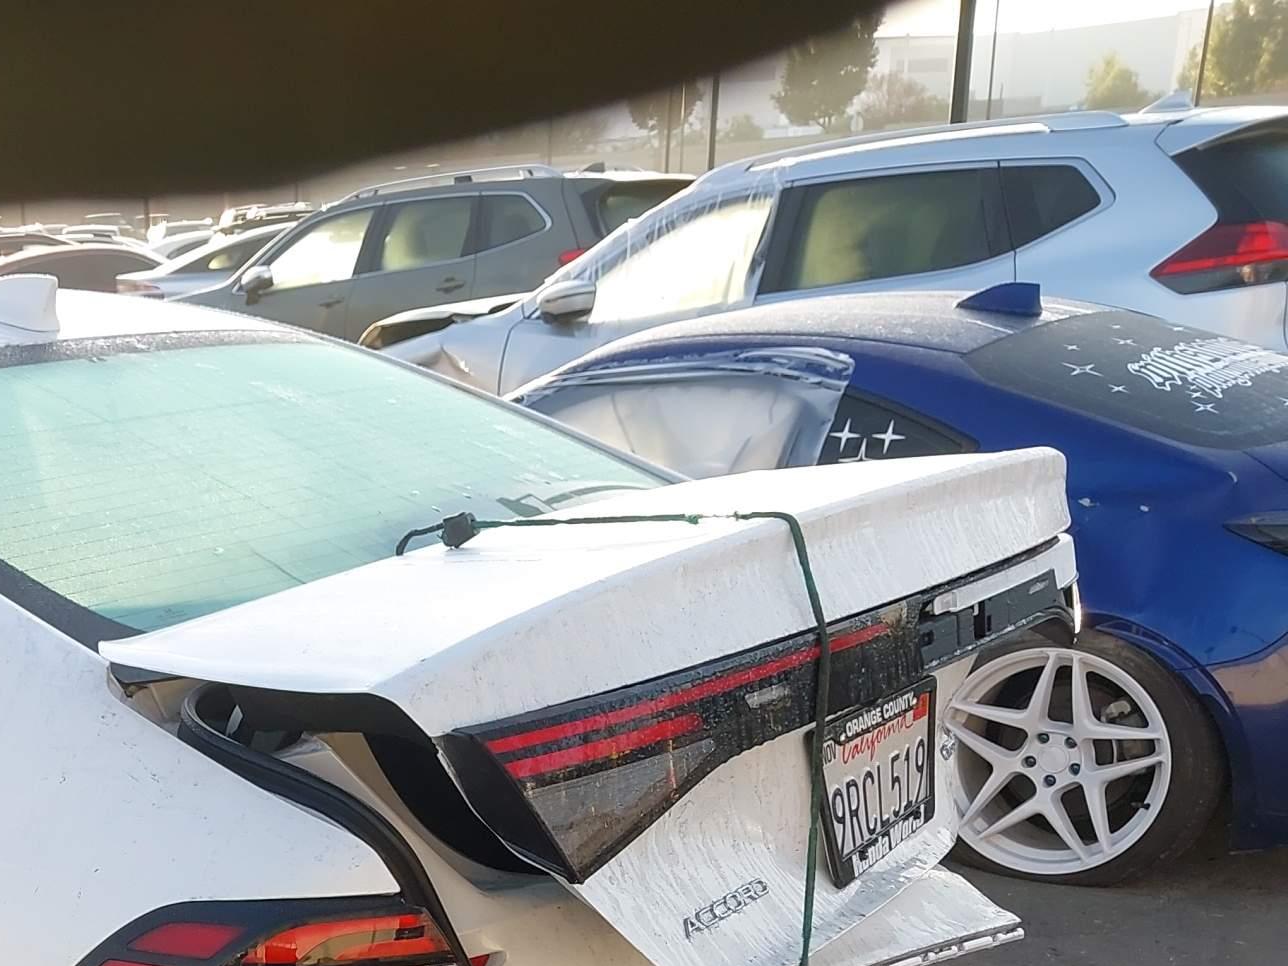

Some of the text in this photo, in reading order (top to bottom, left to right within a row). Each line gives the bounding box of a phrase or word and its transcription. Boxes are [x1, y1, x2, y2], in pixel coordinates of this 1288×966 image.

[841, 712, 914, 765] California
[845, 691, 915, 738] ORANGE COUNTY
[832, 737, 926, 858] 9RCL519
[683, 877, 769, 940] ACCORD
